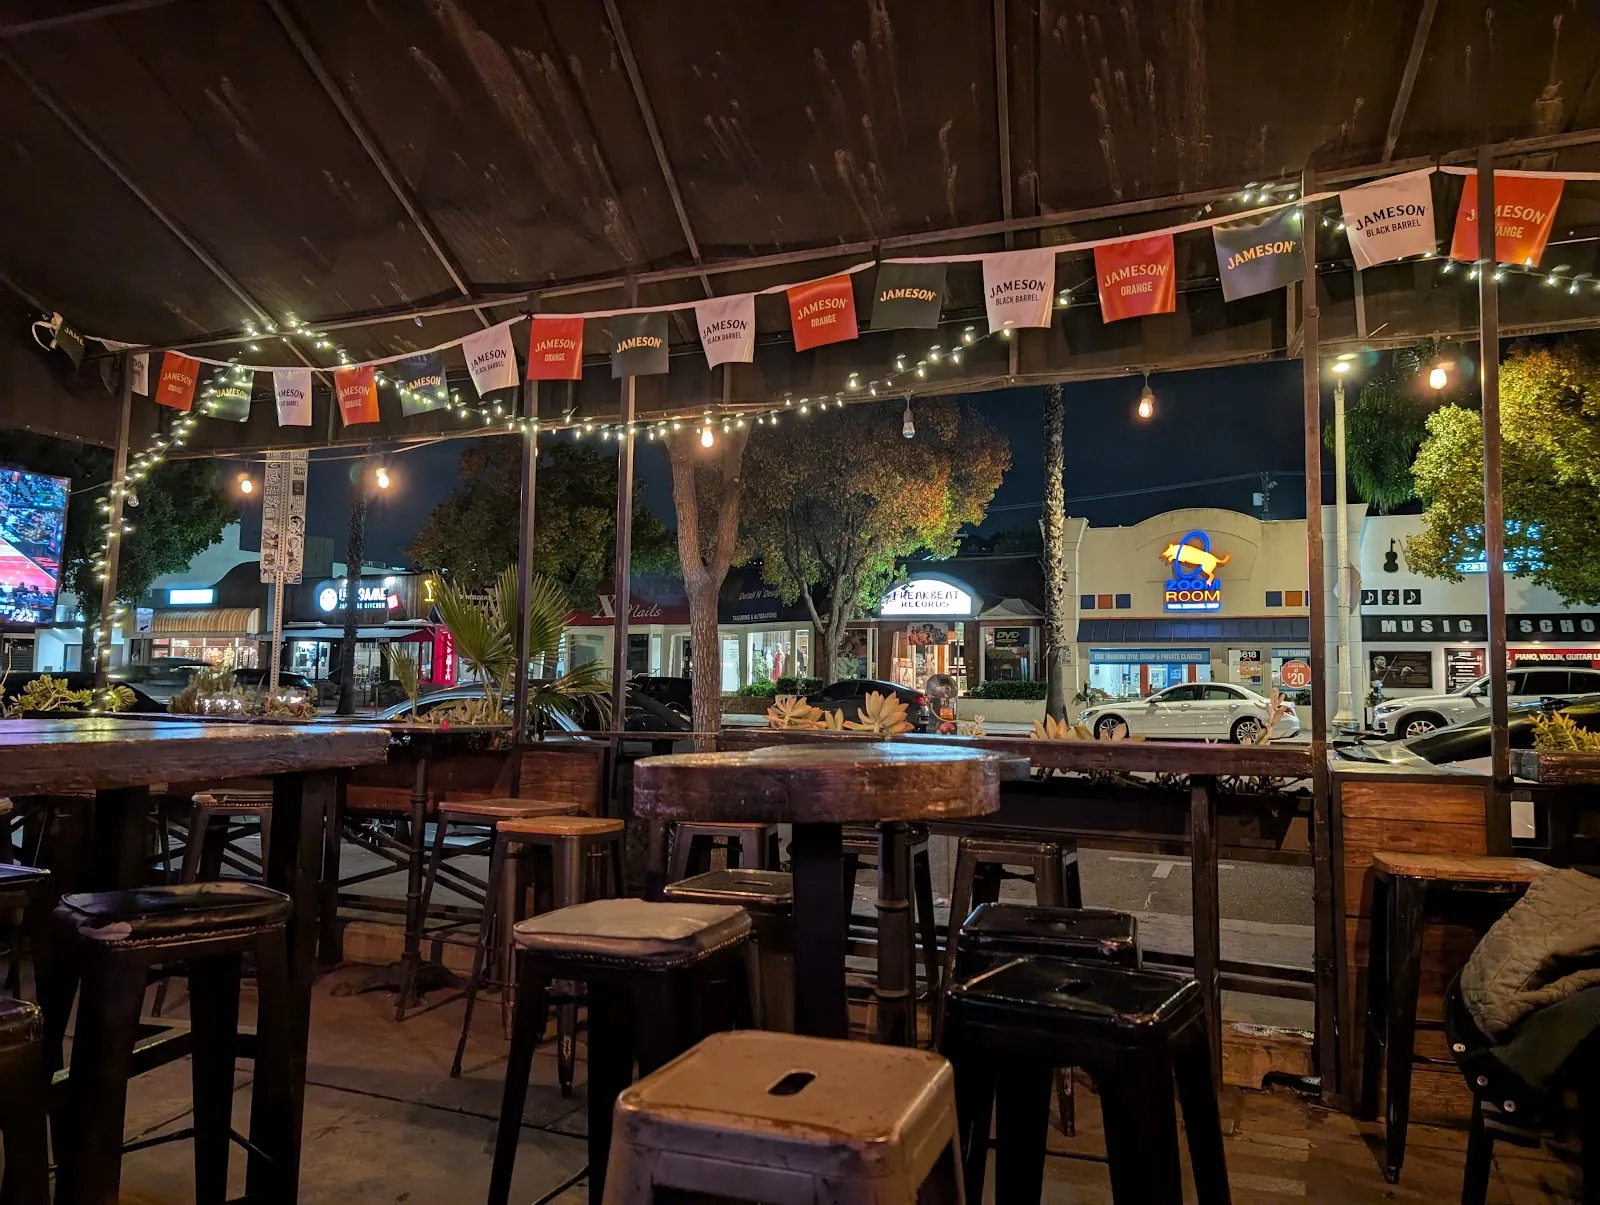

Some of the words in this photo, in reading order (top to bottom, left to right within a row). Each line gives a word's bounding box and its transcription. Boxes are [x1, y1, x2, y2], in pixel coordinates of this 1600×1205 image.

[1355, 204, 1426, 232] JAMESON
[1466, 204, 1545, 225] JMESON
[1366, 224, 1390, 238] BLACK
[1391, 219, 1421, 233] BARREL
[1495, 226, 1524, 239] ANGE
[1227, 240, 1294, 271] JAMESON
[1104, 263, 1166, 288] JAMESON
[880, 288, 935, 302] JAMESON
[989, 279, 1046, 299] JAMESON
[1120, 281, 1153, 297] ORANGE
[995, 297, 1015, 306] BLACK
[1015, 293, 1039, 304] BARREL
[797, 297, 847, 320] JAMESON
[810, 313, 837, 328] ORANGE
[702, 319, 748, 339] JAMESON
[616, 336, 662, 353] JAMESON
[707, 337, 721, 345] BLACK
[722, 331, 742, 342] BARREL
[535, 338, 576, 353] JAMESON
[470, 349, 508, 371] JAMESON
[544, 353, 566, 362] ORANGE
[475, 365, 487, 375] BLACK
[487, 361, 504, 372] BARREL
[163, 372, 193, 387] JAMESON
[167, 383, 184, 394] ORANGE
[216, 387, 249, 401] JAMESON
[278, 389, 305, 400] AMESON
[1165, 579, 1221, 591] ZOOM
[892, 590, 959, 601] FREAKBEAT
[1165, 590, 1220, 602] ROOM
[628, 603, 664, 618] Nails
[901, 600, 950, 608] RECORDS
[1381, 619, 1473, 633] MUSIC
[1519, 619, 1595, 633] SCHO
[996, 631, 1020, 639] DVD
[1161, 652, 1180, 660] PRIVATE
[1180, 652, 1202, 660] CLASSES
[1515, 653, 1539, 661] PIANO,
[1539, 653, 1565, 661] VIOLIN,
[1566, 653, 1592, 661] GUITAR
[1287, 673, 1305, 685] $20
